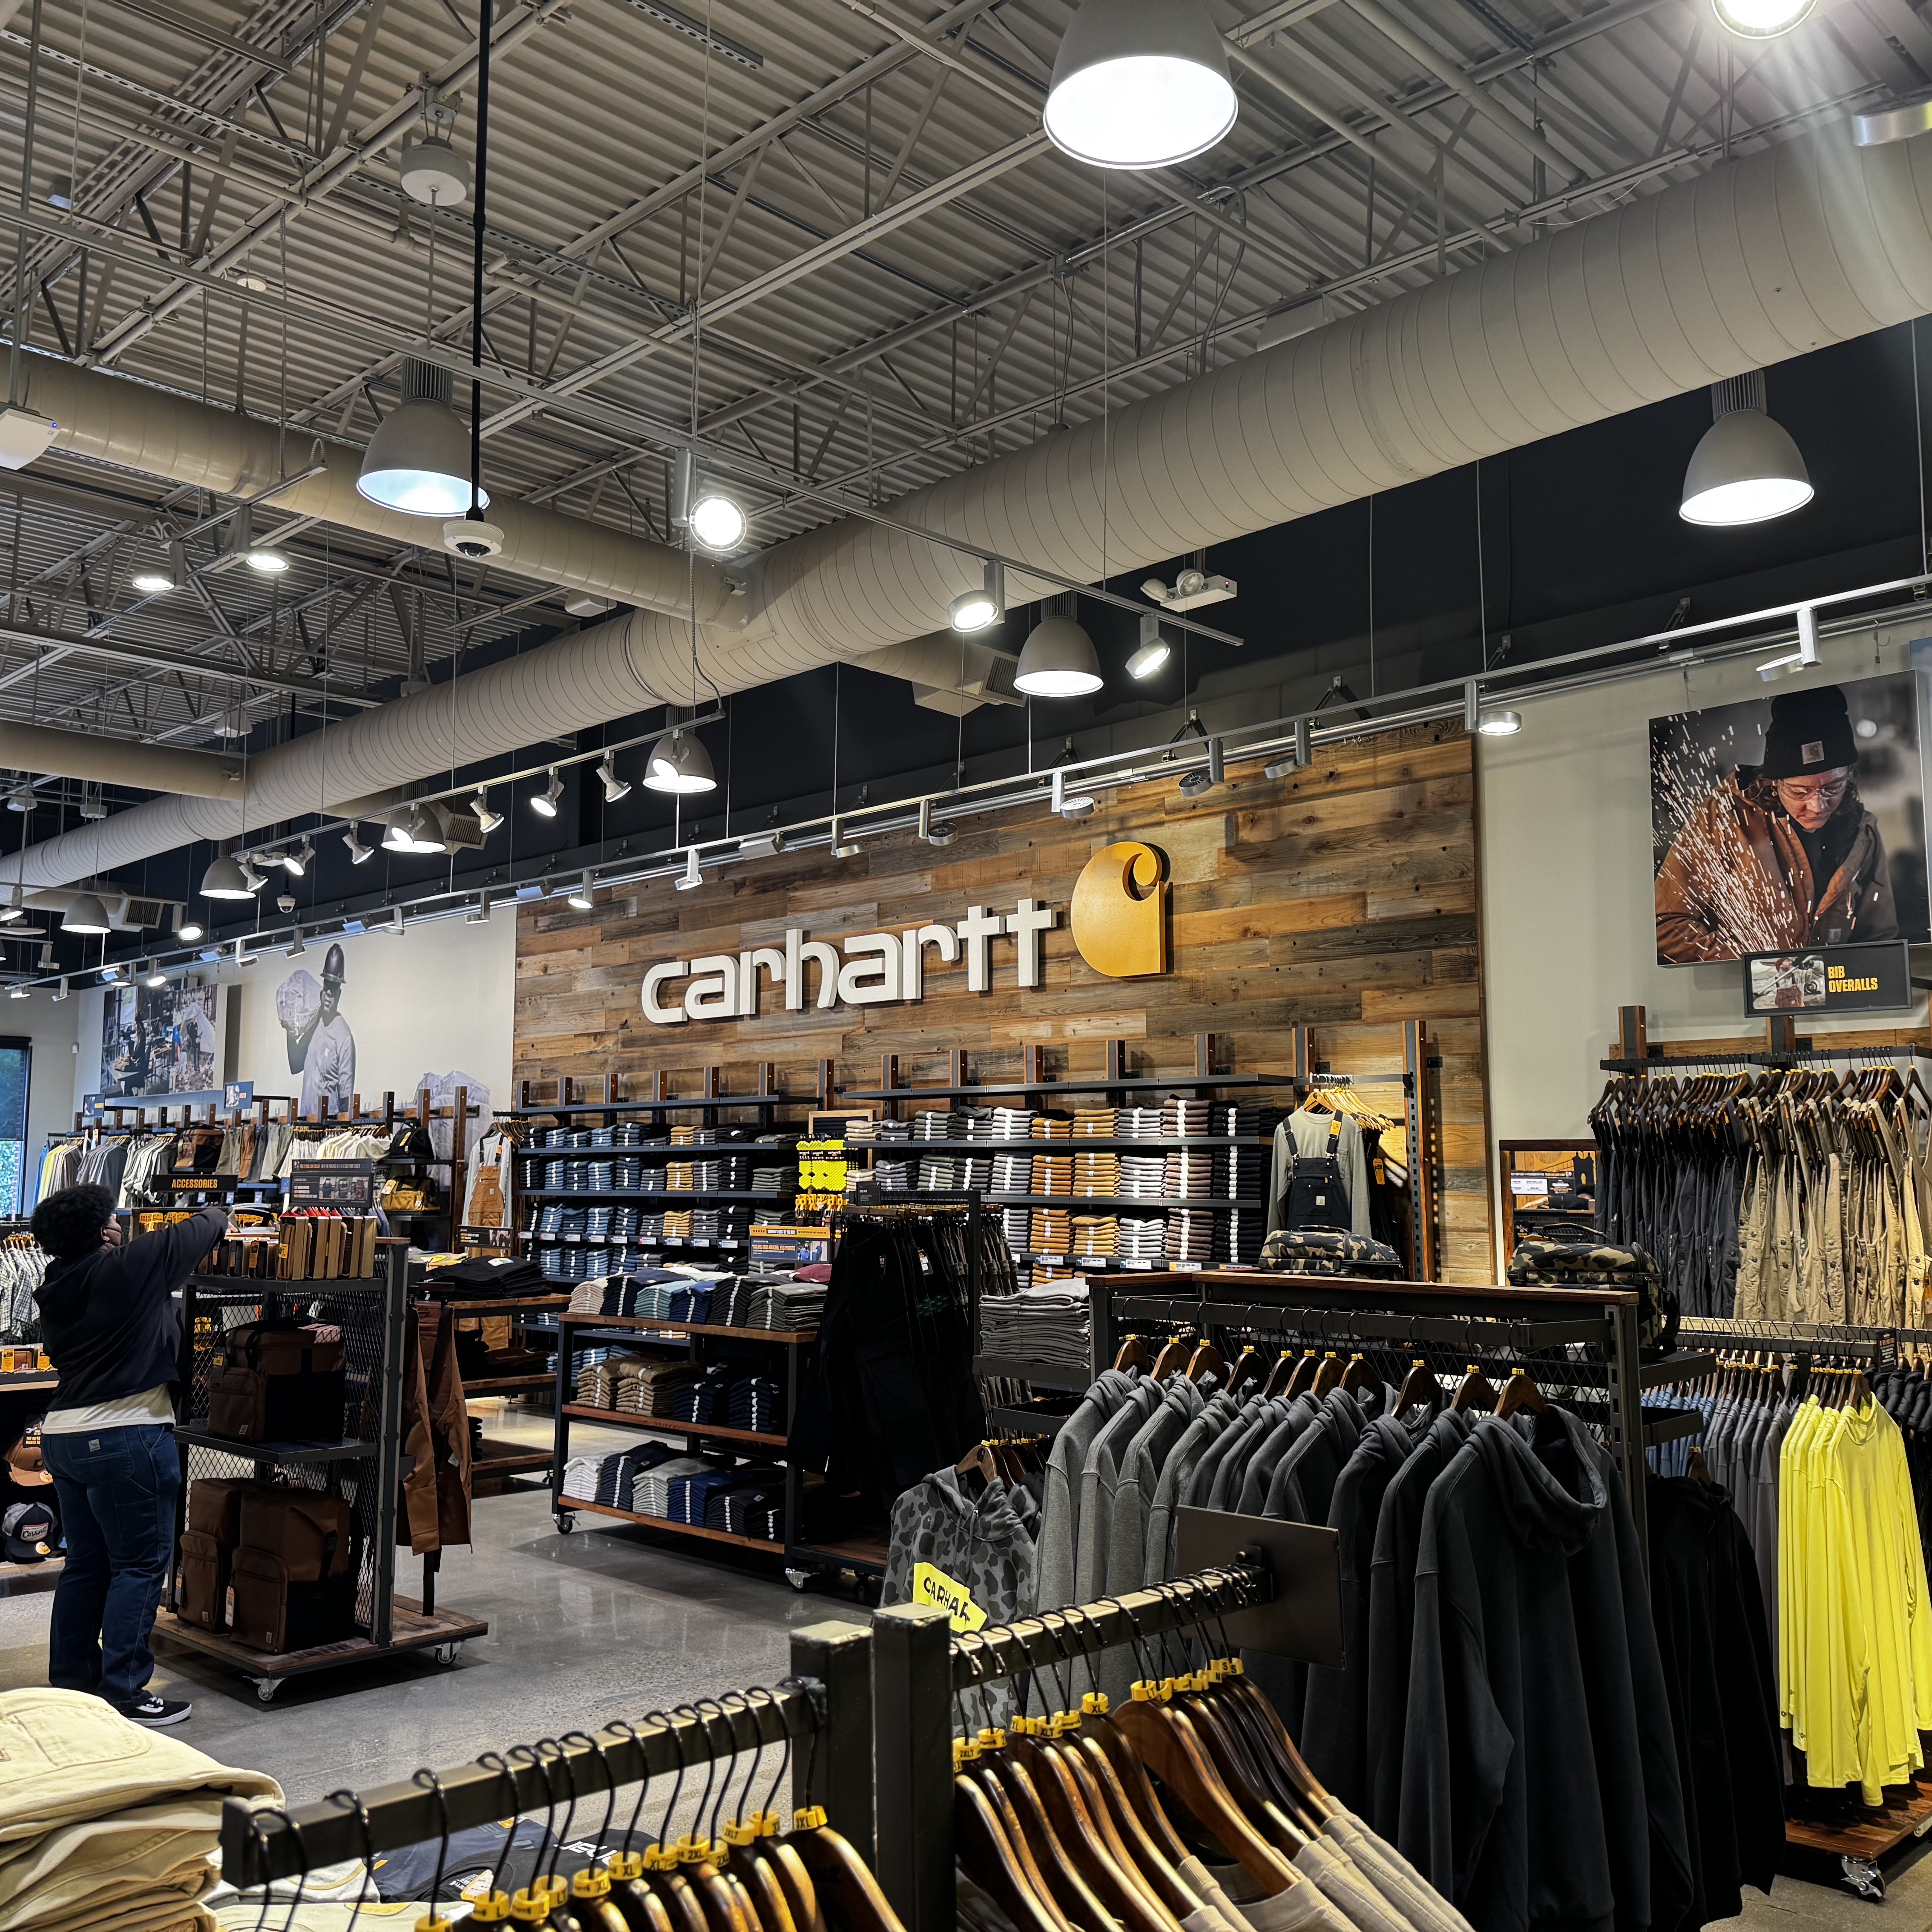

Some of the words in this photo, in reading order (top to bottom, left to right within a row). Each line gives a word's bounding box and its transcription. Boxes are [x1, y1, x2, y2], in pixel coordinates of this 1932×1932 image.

[641, 897, 1057, 1024] carhartt
[1828, 966, 1845, 979] BIB
[1829, 977, 1878, 993] OVERALLS
[171, 1178, 218, 1189] ACCESSORIES
[1231, 1665, 1237, 1674] S
[1146, 1687, 1155, 1699] LT
[1092, 1705, 1103, 1713] XL
[1040, 1727, 1055, 1737] XLT
[688, 1850, 704, 1860] 2XL
[623, 1864, 635, 1877] XL
[496, 1906, 504, 1918] L
